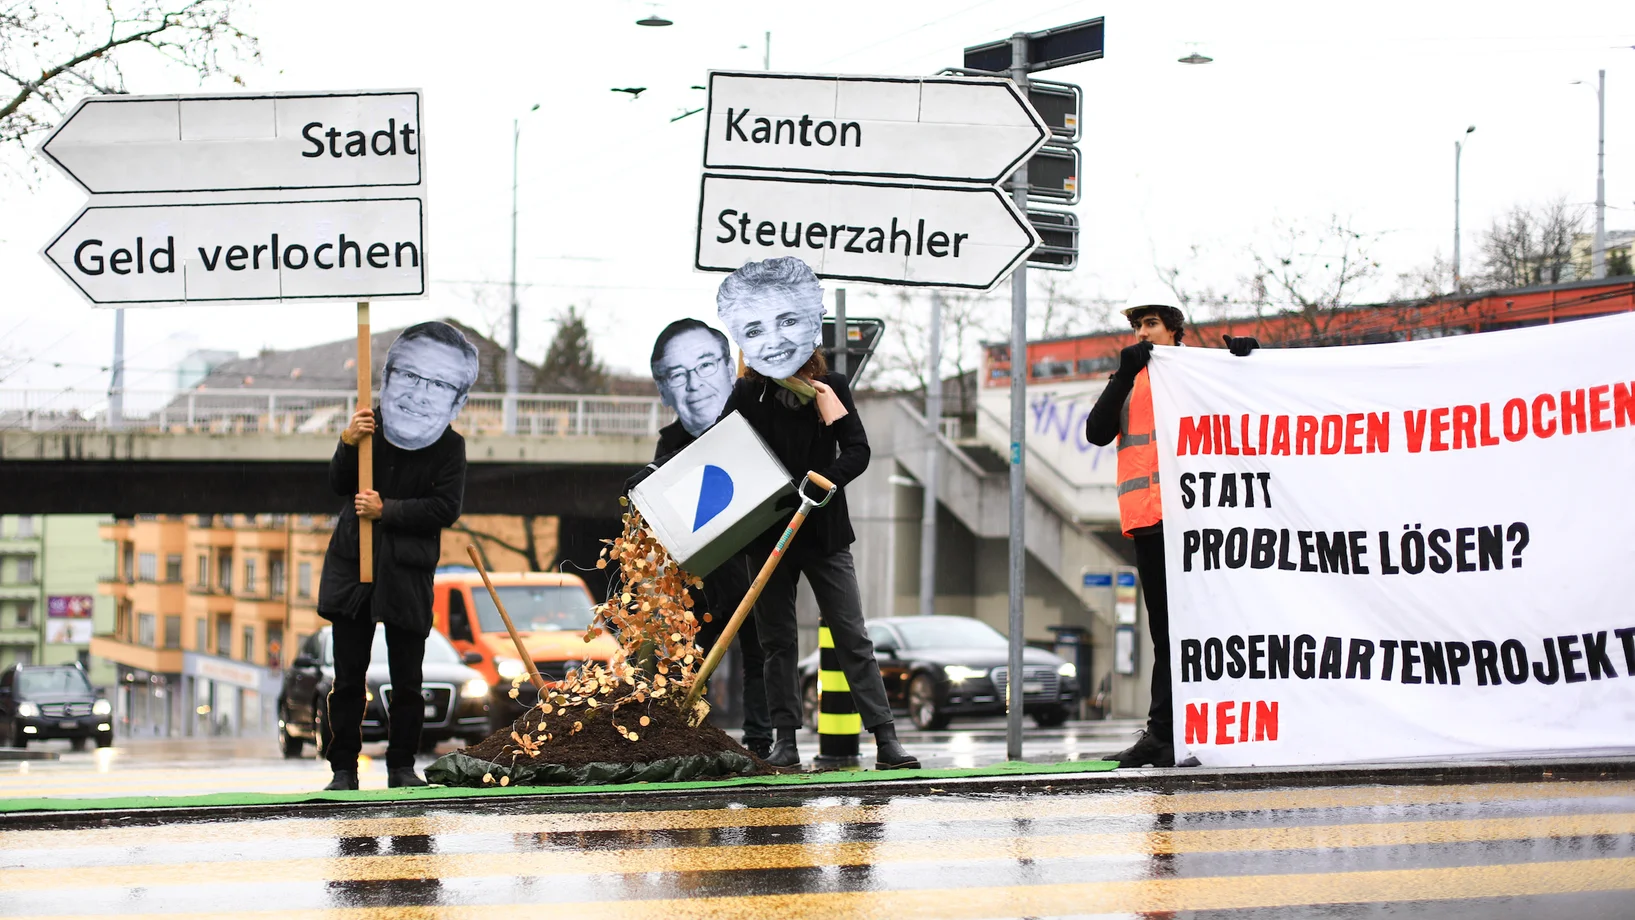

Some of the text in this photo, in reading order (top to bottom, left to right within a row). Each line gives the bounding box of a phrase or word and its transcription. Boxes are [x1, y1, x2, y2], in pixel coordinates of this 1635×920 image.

[301, 118, 417, 158] Stadt
[725, 107, 862, 148] Kanton
[74, 233, 419, 276] Geld verlochen
[716, 208, 969, 258] Steuerzahler
[1176, 381, 1635, 457] MILLIARDEN VERLOCHEN
[1179, 471, 1272, 510] STATT
[1183, 521, 1530, 576] PROBLEME LÖSEN?
[1180, 626, 1635, 686] ROSENGARTENPROJEKT
[1184, 699, 1279, 746] NEIN
